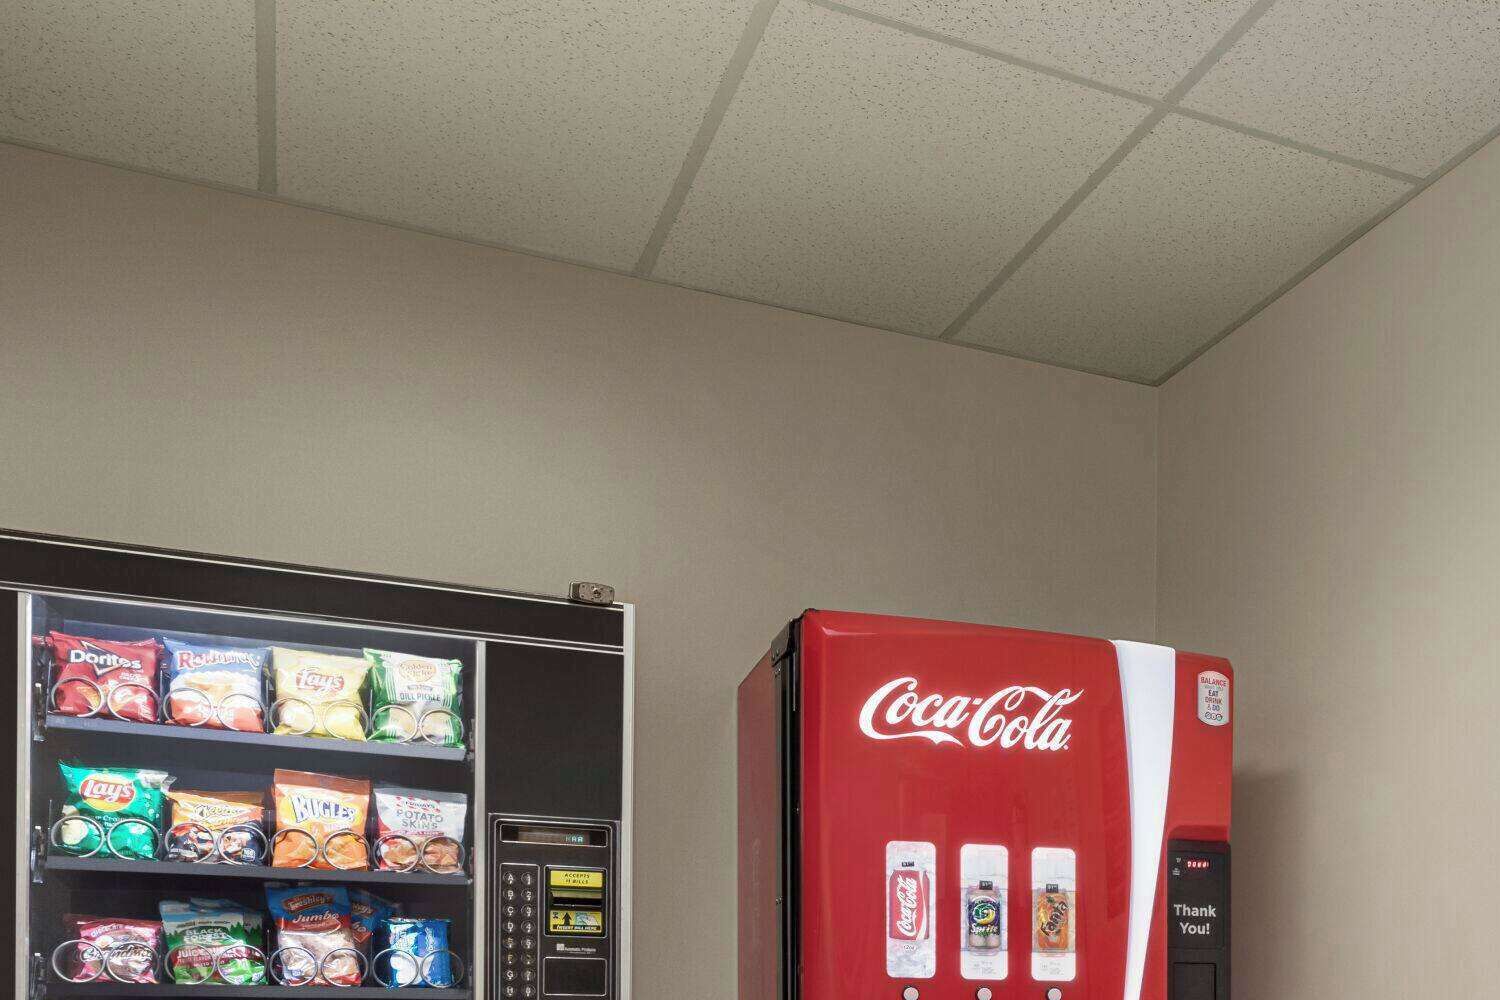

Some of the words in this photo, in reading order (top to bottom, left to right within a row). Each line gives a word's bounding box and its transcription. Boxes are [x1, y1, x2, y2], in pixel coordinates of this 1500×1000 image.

[70, 649, 142, 670] Doritos
[1200, 677, 1227, 687] BALANCE
[858, 676, 1084, 752] Coca-Cola
[396, 809, 444, 823] POTATO
[401, 818, 438, 830] SKINS
[292, 910, 340, 924] Jumbo
[1173, 903, 1217, 918] Thank
[970, 922, 999, 936] Sprite
[1179, 921, 1210, 935] You!
